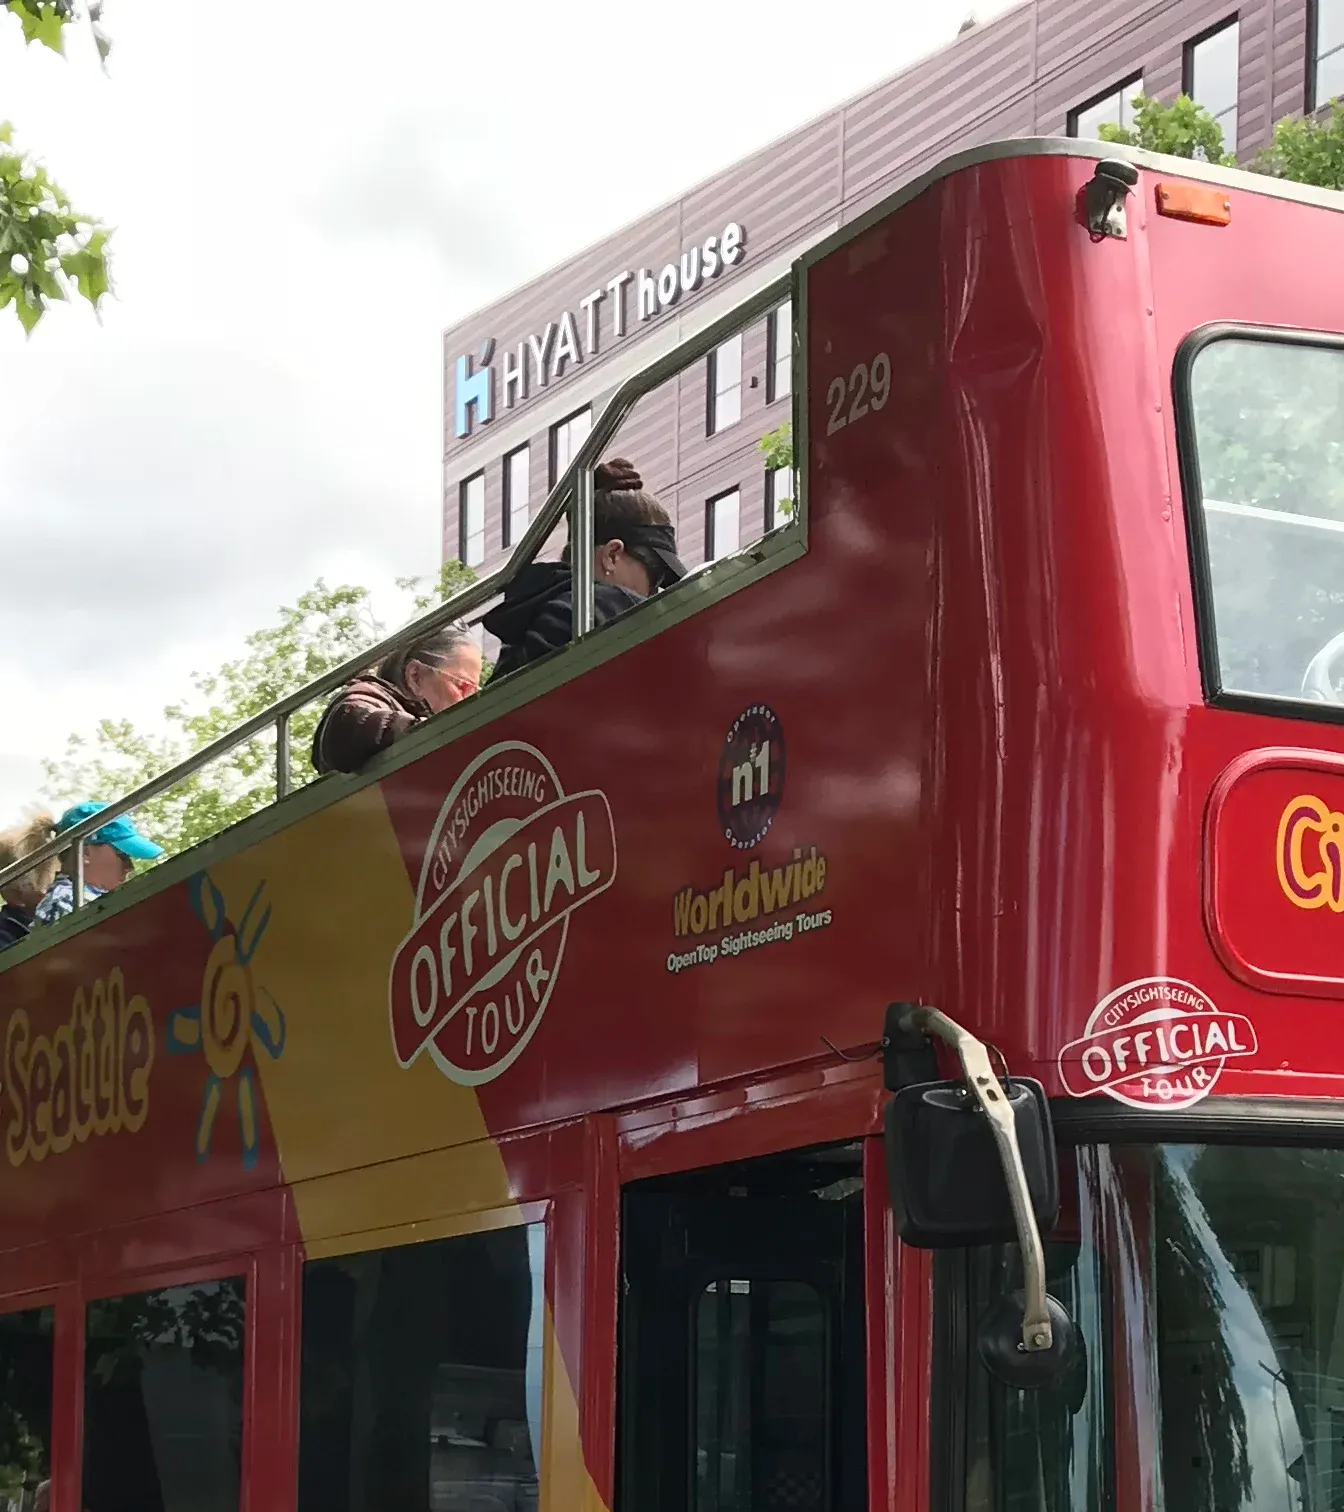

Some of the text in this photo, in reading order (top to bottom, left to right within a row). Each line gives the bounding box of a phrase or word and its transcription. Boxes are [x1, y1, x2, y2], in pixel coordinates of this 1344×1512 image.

[825, 351, 893, 436] 229
[431, 766, 547, 891] CITYSIGHTSEEING
[410, 810, 601, 1027] OFFICIAL
[673, 846, 827, 937] Worldwide
[721, 920, 794, 956] Sightseeing
[796, 909, 832, 932] Tours
[465, 949, 551, 1055] TOUR
[1104, 986, 1205, 1026] CITYSIGHTSEEING
[5, 966, 153, 1167] Seattle
[1082, 1020, 1246, 1082] OFFICIAL
[1141, 1066, 1211, 1099] TOUR
